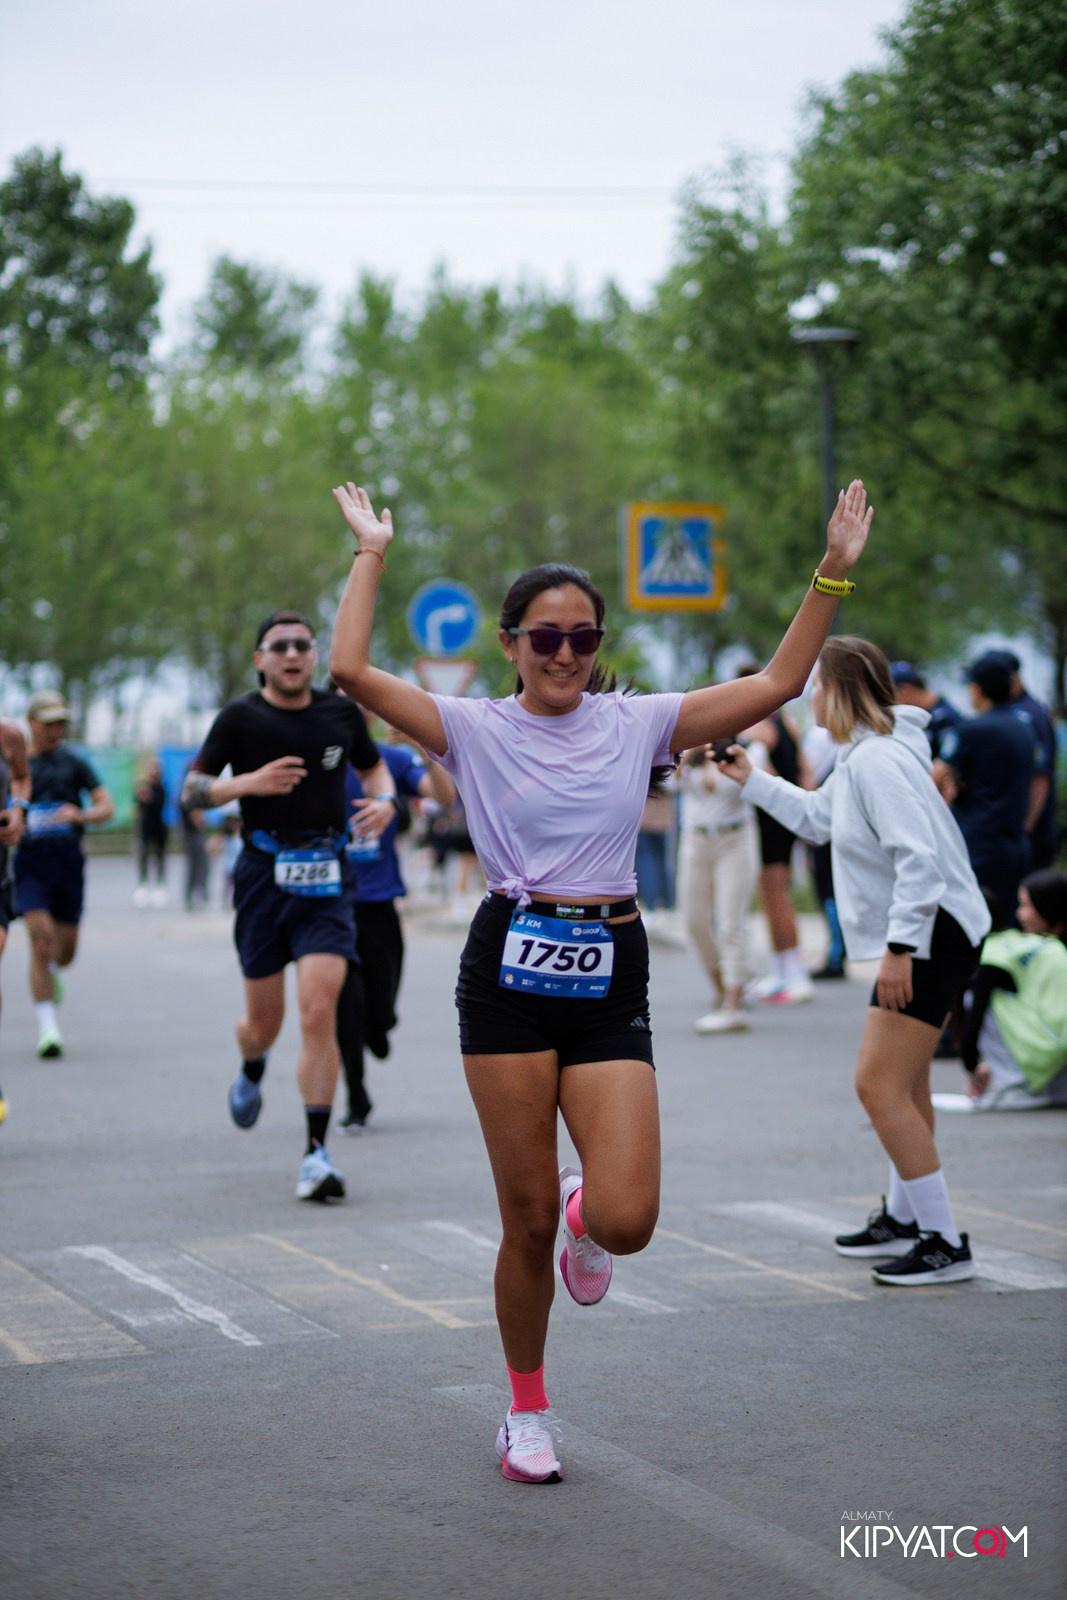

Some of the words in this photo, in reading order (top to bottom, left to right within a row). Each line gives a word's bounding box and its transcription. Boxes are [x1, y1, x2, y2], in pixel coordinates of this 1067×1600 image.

[285, 863, 330, 881] 1286
[516, 915, 526, 925] 5
[526, 919, 542, 929] KM
[582, 927, 600, 935] GROUP
[517, 938, 602, 973] 1750
